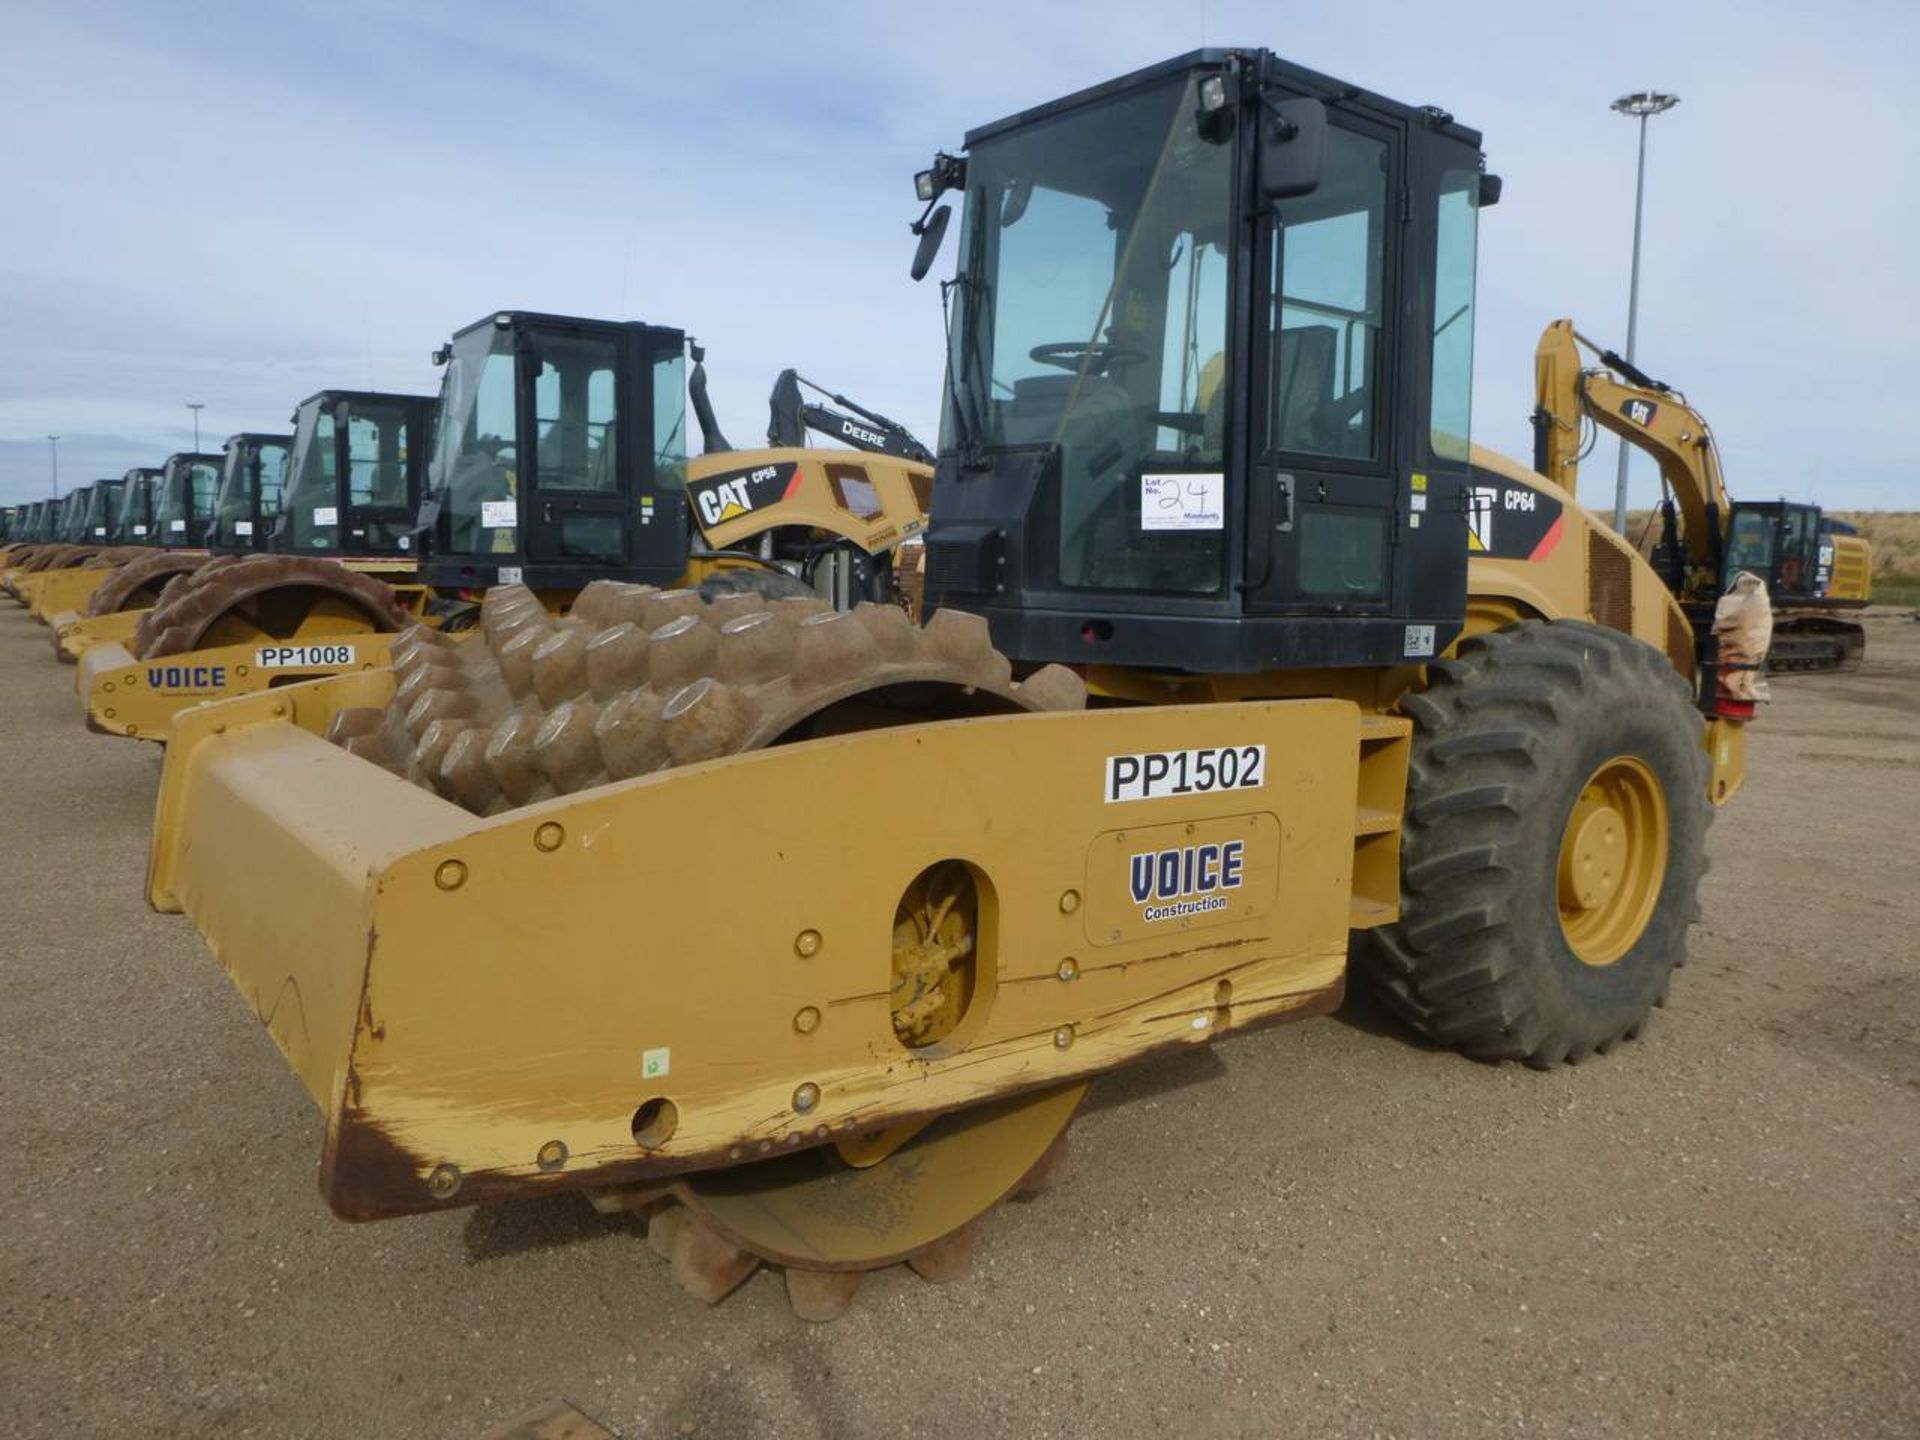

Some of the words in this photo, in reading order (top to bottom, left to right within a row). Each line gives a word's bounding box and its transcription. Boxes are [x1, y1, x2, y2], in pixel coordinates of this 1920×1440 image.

[842, 421, 886, 447] DEERE
[698, 477, 752, 524] CAT
[1159, 480, 1208, 513] 24
[1504, 489, 1536, 512] CP64
[262, 646, 349, 666] PP1008
[148, 667, 225, 688] VOICE
[1112, 746, 1260, 800] PP1502
[1131, 840, 1243, 903] VOICE
[1144, 896, 1227, 921] Construction
